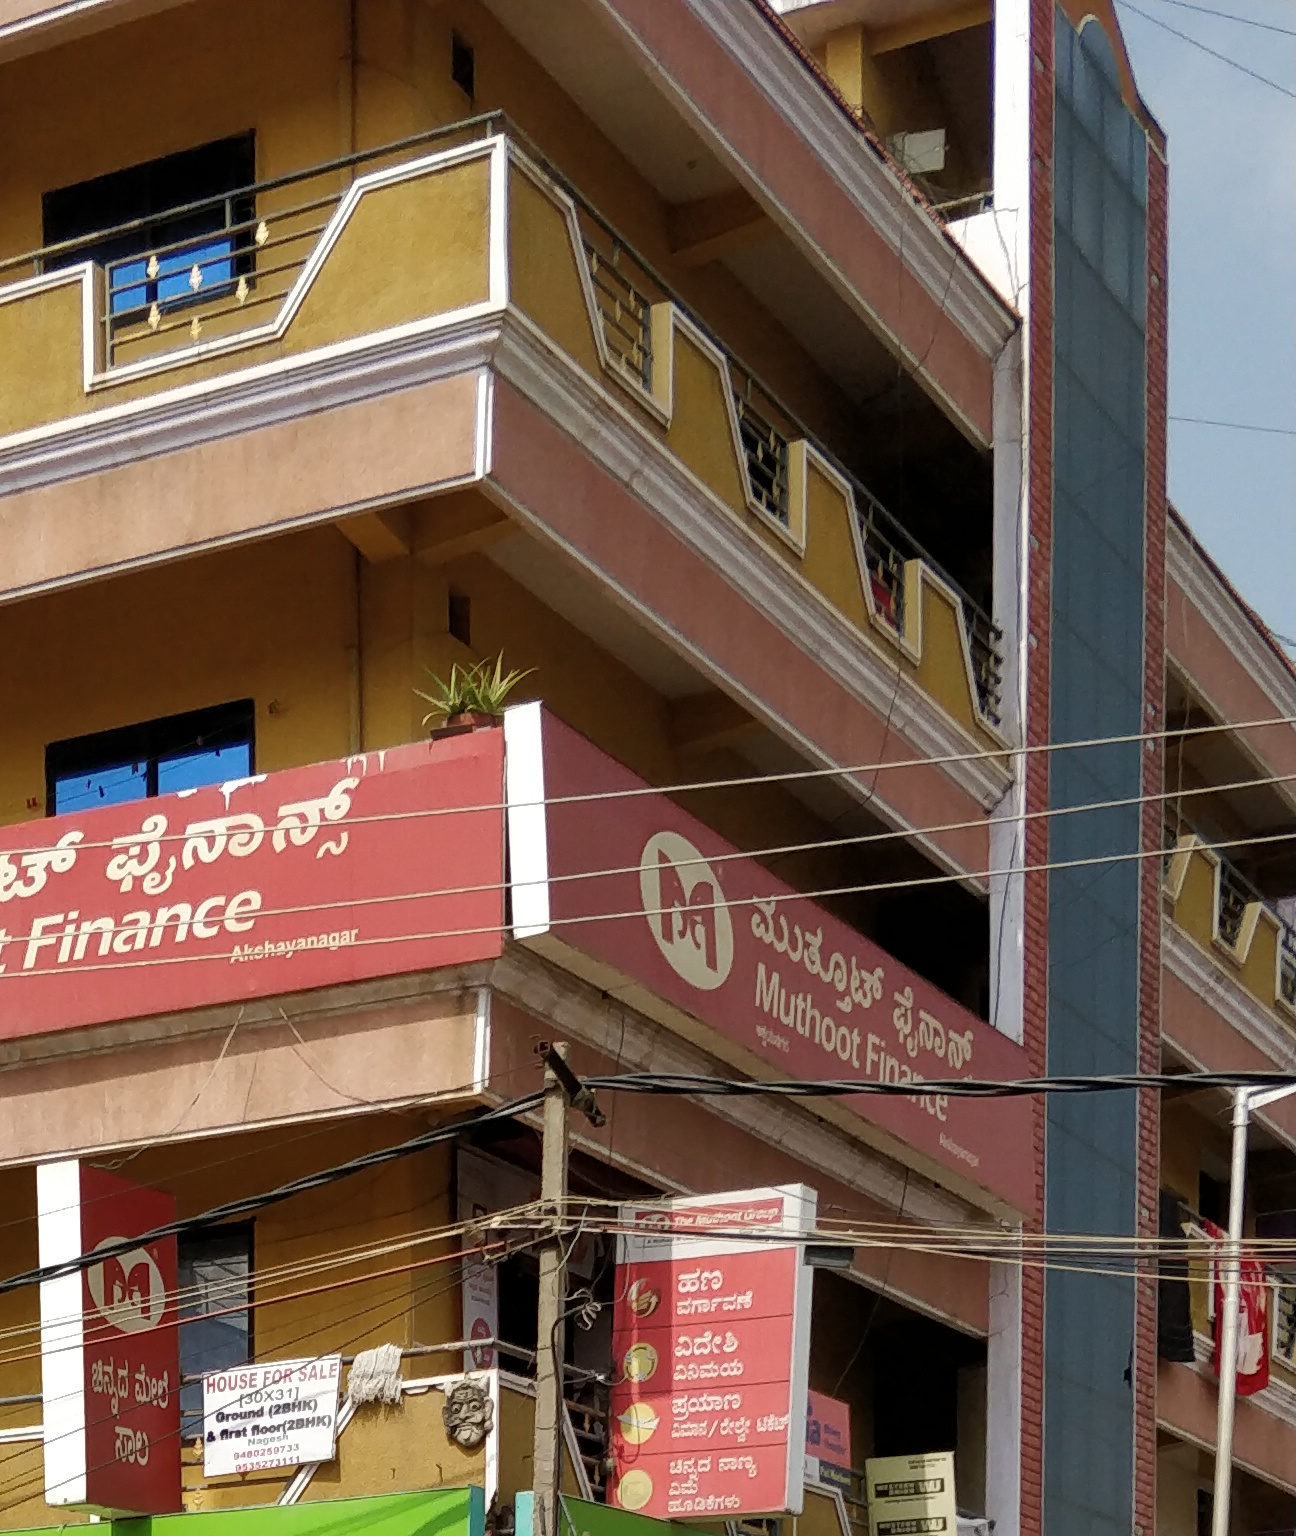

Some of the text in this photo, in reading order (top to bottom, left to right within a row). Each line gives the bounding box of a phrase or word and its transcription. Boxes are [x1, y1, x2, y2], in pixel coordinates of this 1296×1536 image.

[23, 889, 262, 969] Finance
[229, 929, 359, 964] Akshayanagar
[755, 962, 862, 1069] Muthoot
[677, 1267, 723, 1293] ಹಣ
[206, 1363, 338, 1394] HOUSE FOR SALE
[215, 1399, 318, 1423] Ground (2BHK)
[206, 1431, 216, 1442] &
[220, 1427, 247, 1440] first
